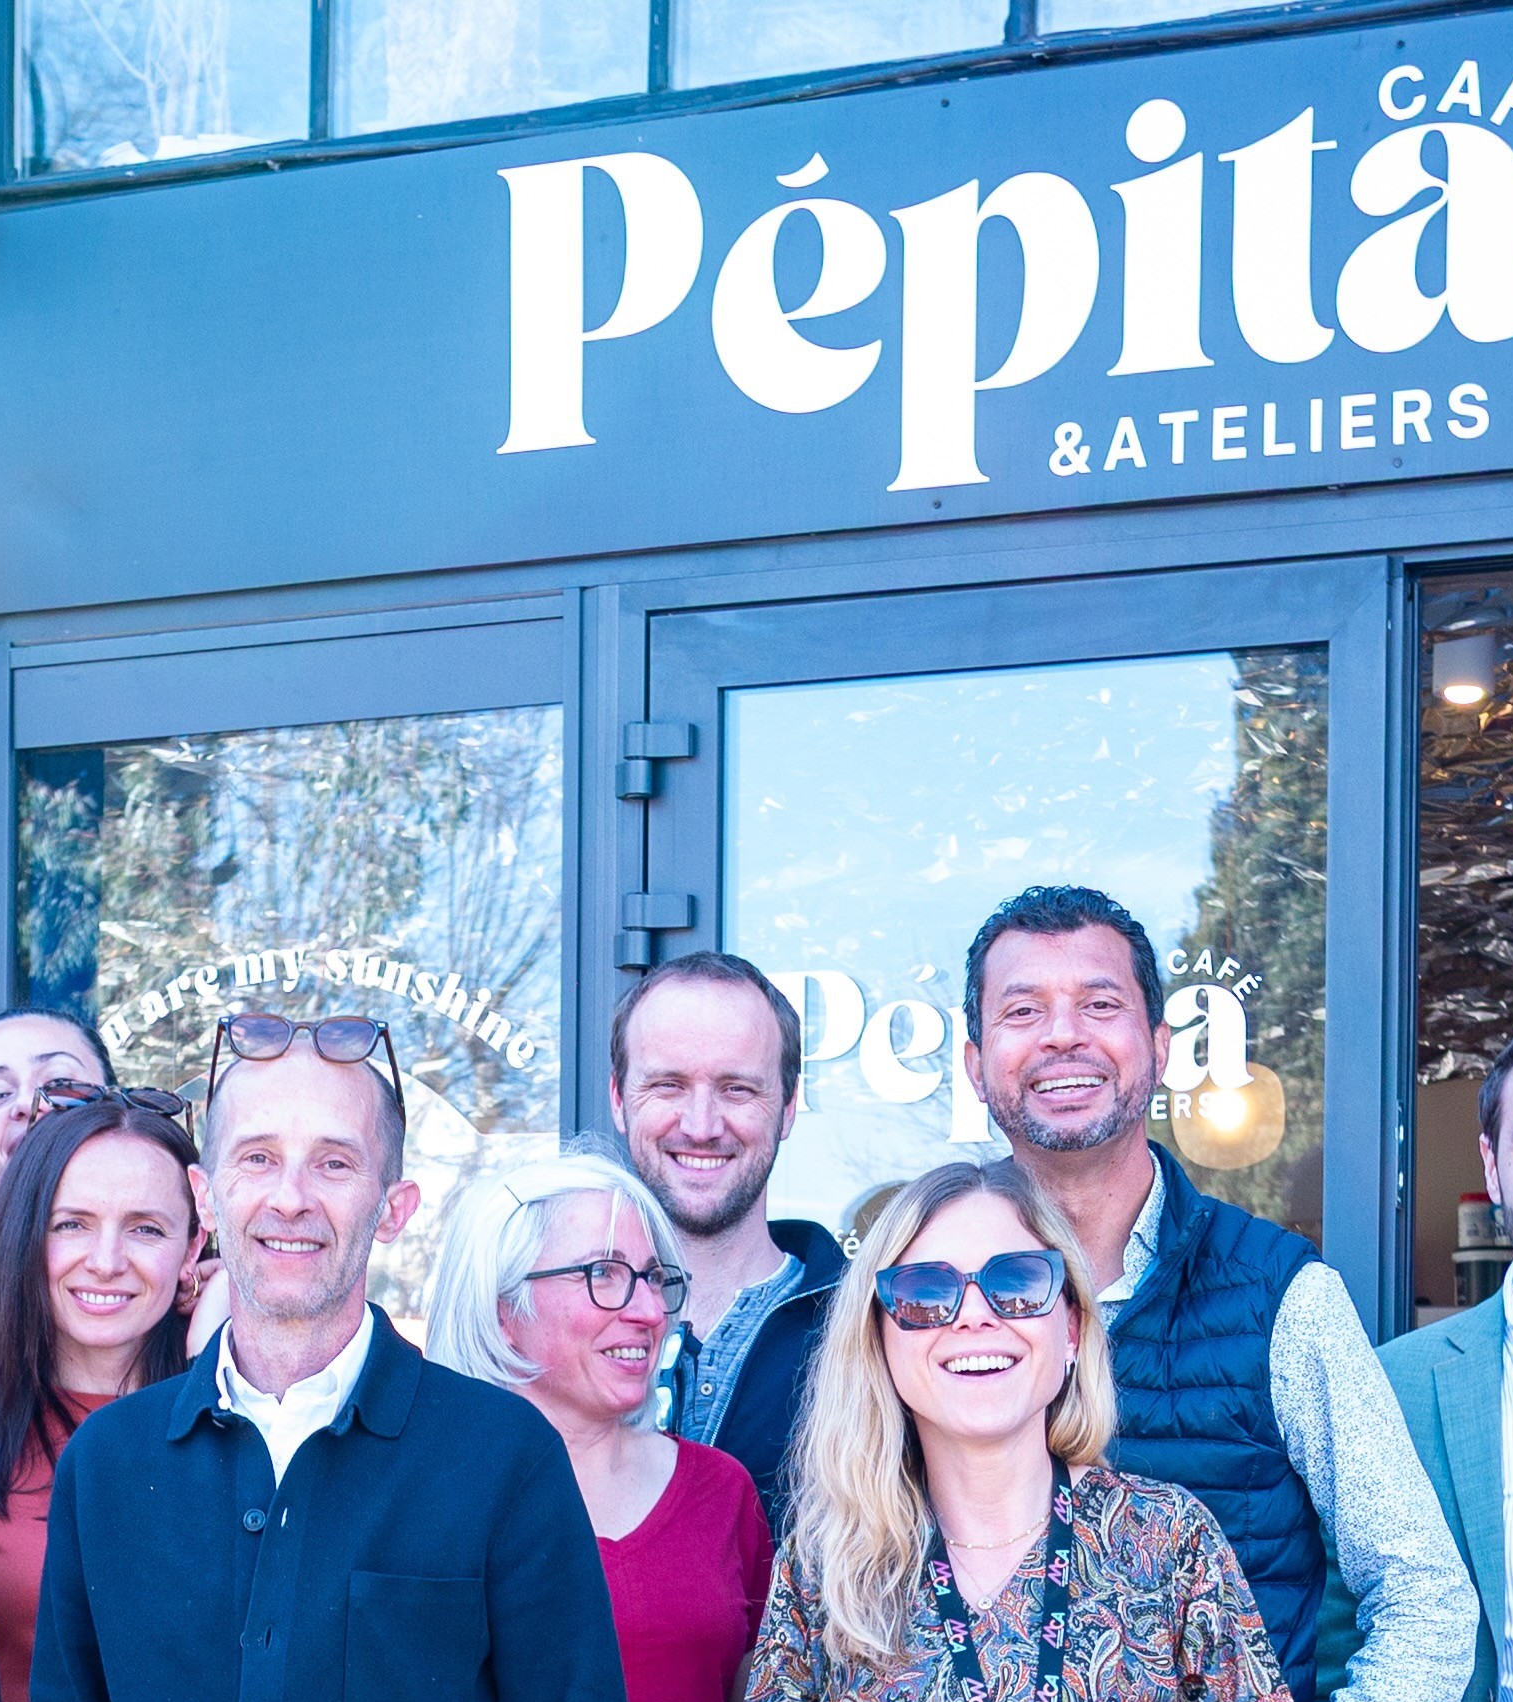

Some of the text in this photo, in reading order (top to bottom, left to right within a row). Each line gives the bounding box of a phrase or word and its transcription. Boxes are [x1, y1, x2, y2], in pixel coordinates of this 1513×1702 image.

[1166, 948, 1264, 1002] CAFÉ
[139, 948, 536, 1070] are my sunshine
[1053, 1484, 1073, 1525] MCA
[932, 1560, 953, 1596] MCA
[1047, 1549, 1070, 1588] MCA
[949, 1618, 969, 1653] MCA
[1041, 1612, 1066, 1650] MCA
